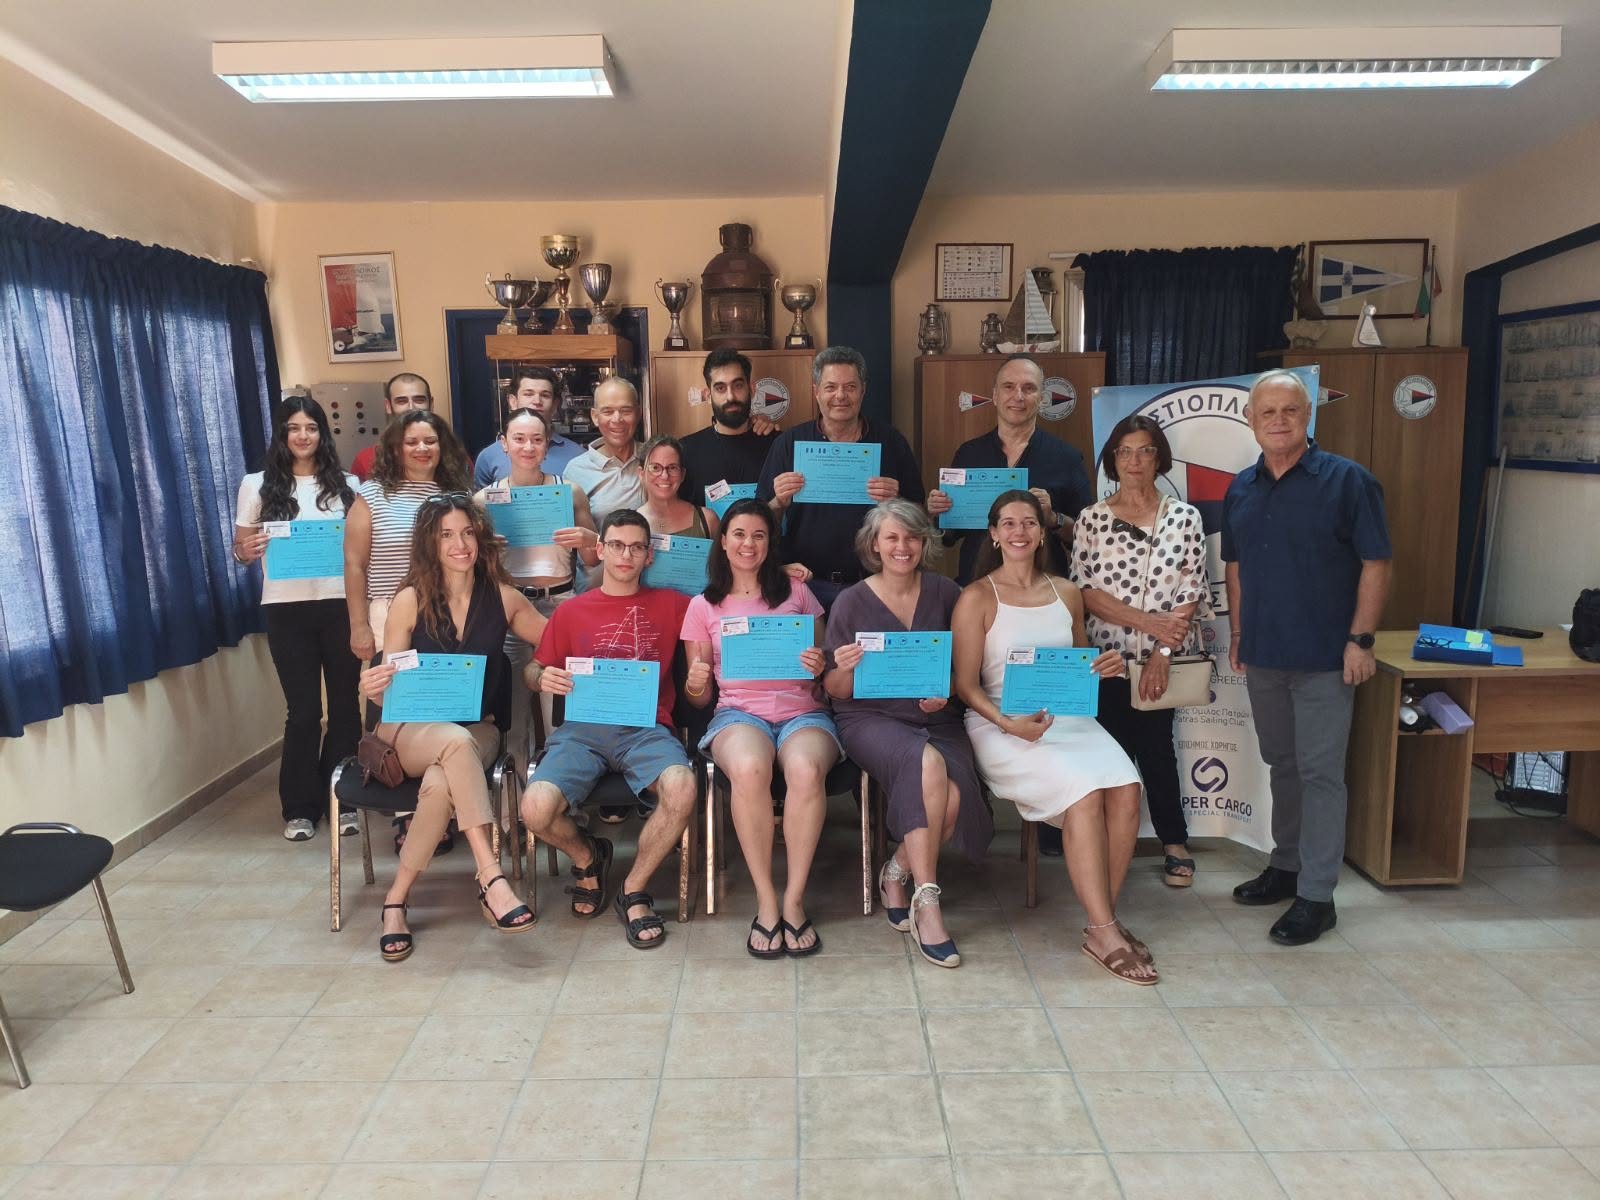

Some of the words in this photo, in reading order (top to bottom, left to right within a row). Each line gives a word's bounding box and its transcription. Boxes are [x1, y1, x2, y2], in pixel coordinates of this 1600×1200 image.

[1210, 675, 1248, 685] GREECE
[1200, 715, 1228, 727] Sailing
[1181, 796, 1209, 808] PER
[1214, 797, 1252, 816] CARGO
